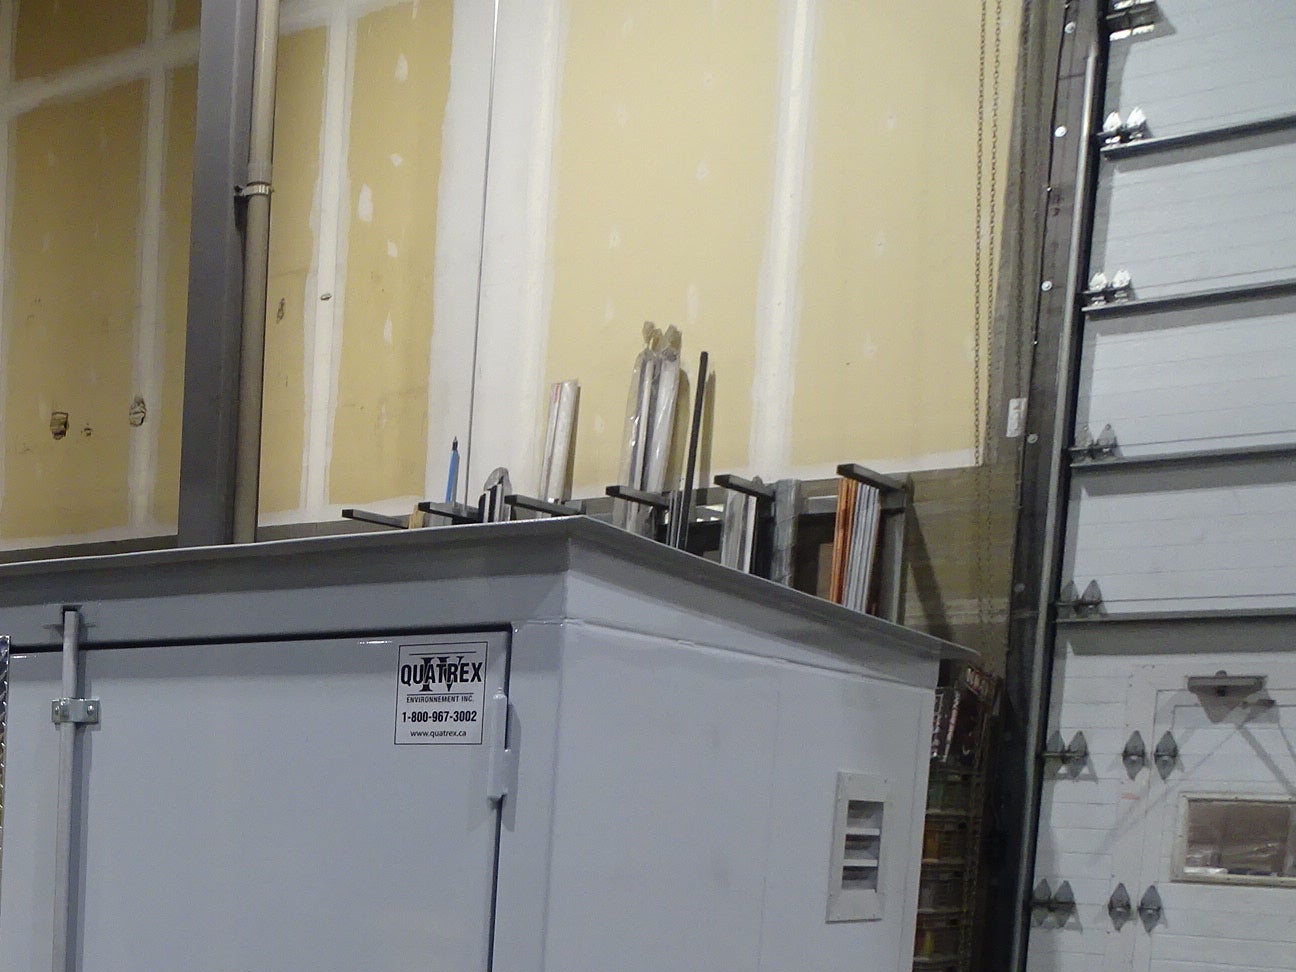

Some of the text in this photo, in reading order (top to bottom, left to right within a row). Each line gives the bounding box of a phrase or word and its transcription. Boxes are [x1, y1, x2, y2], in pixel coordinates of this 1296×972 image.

[400, 661, 483, 687] QUATREX
[402, 710, 477, 723] 1-800-967-3002
[410, 729, 467, 738] www.quatrex.ca
